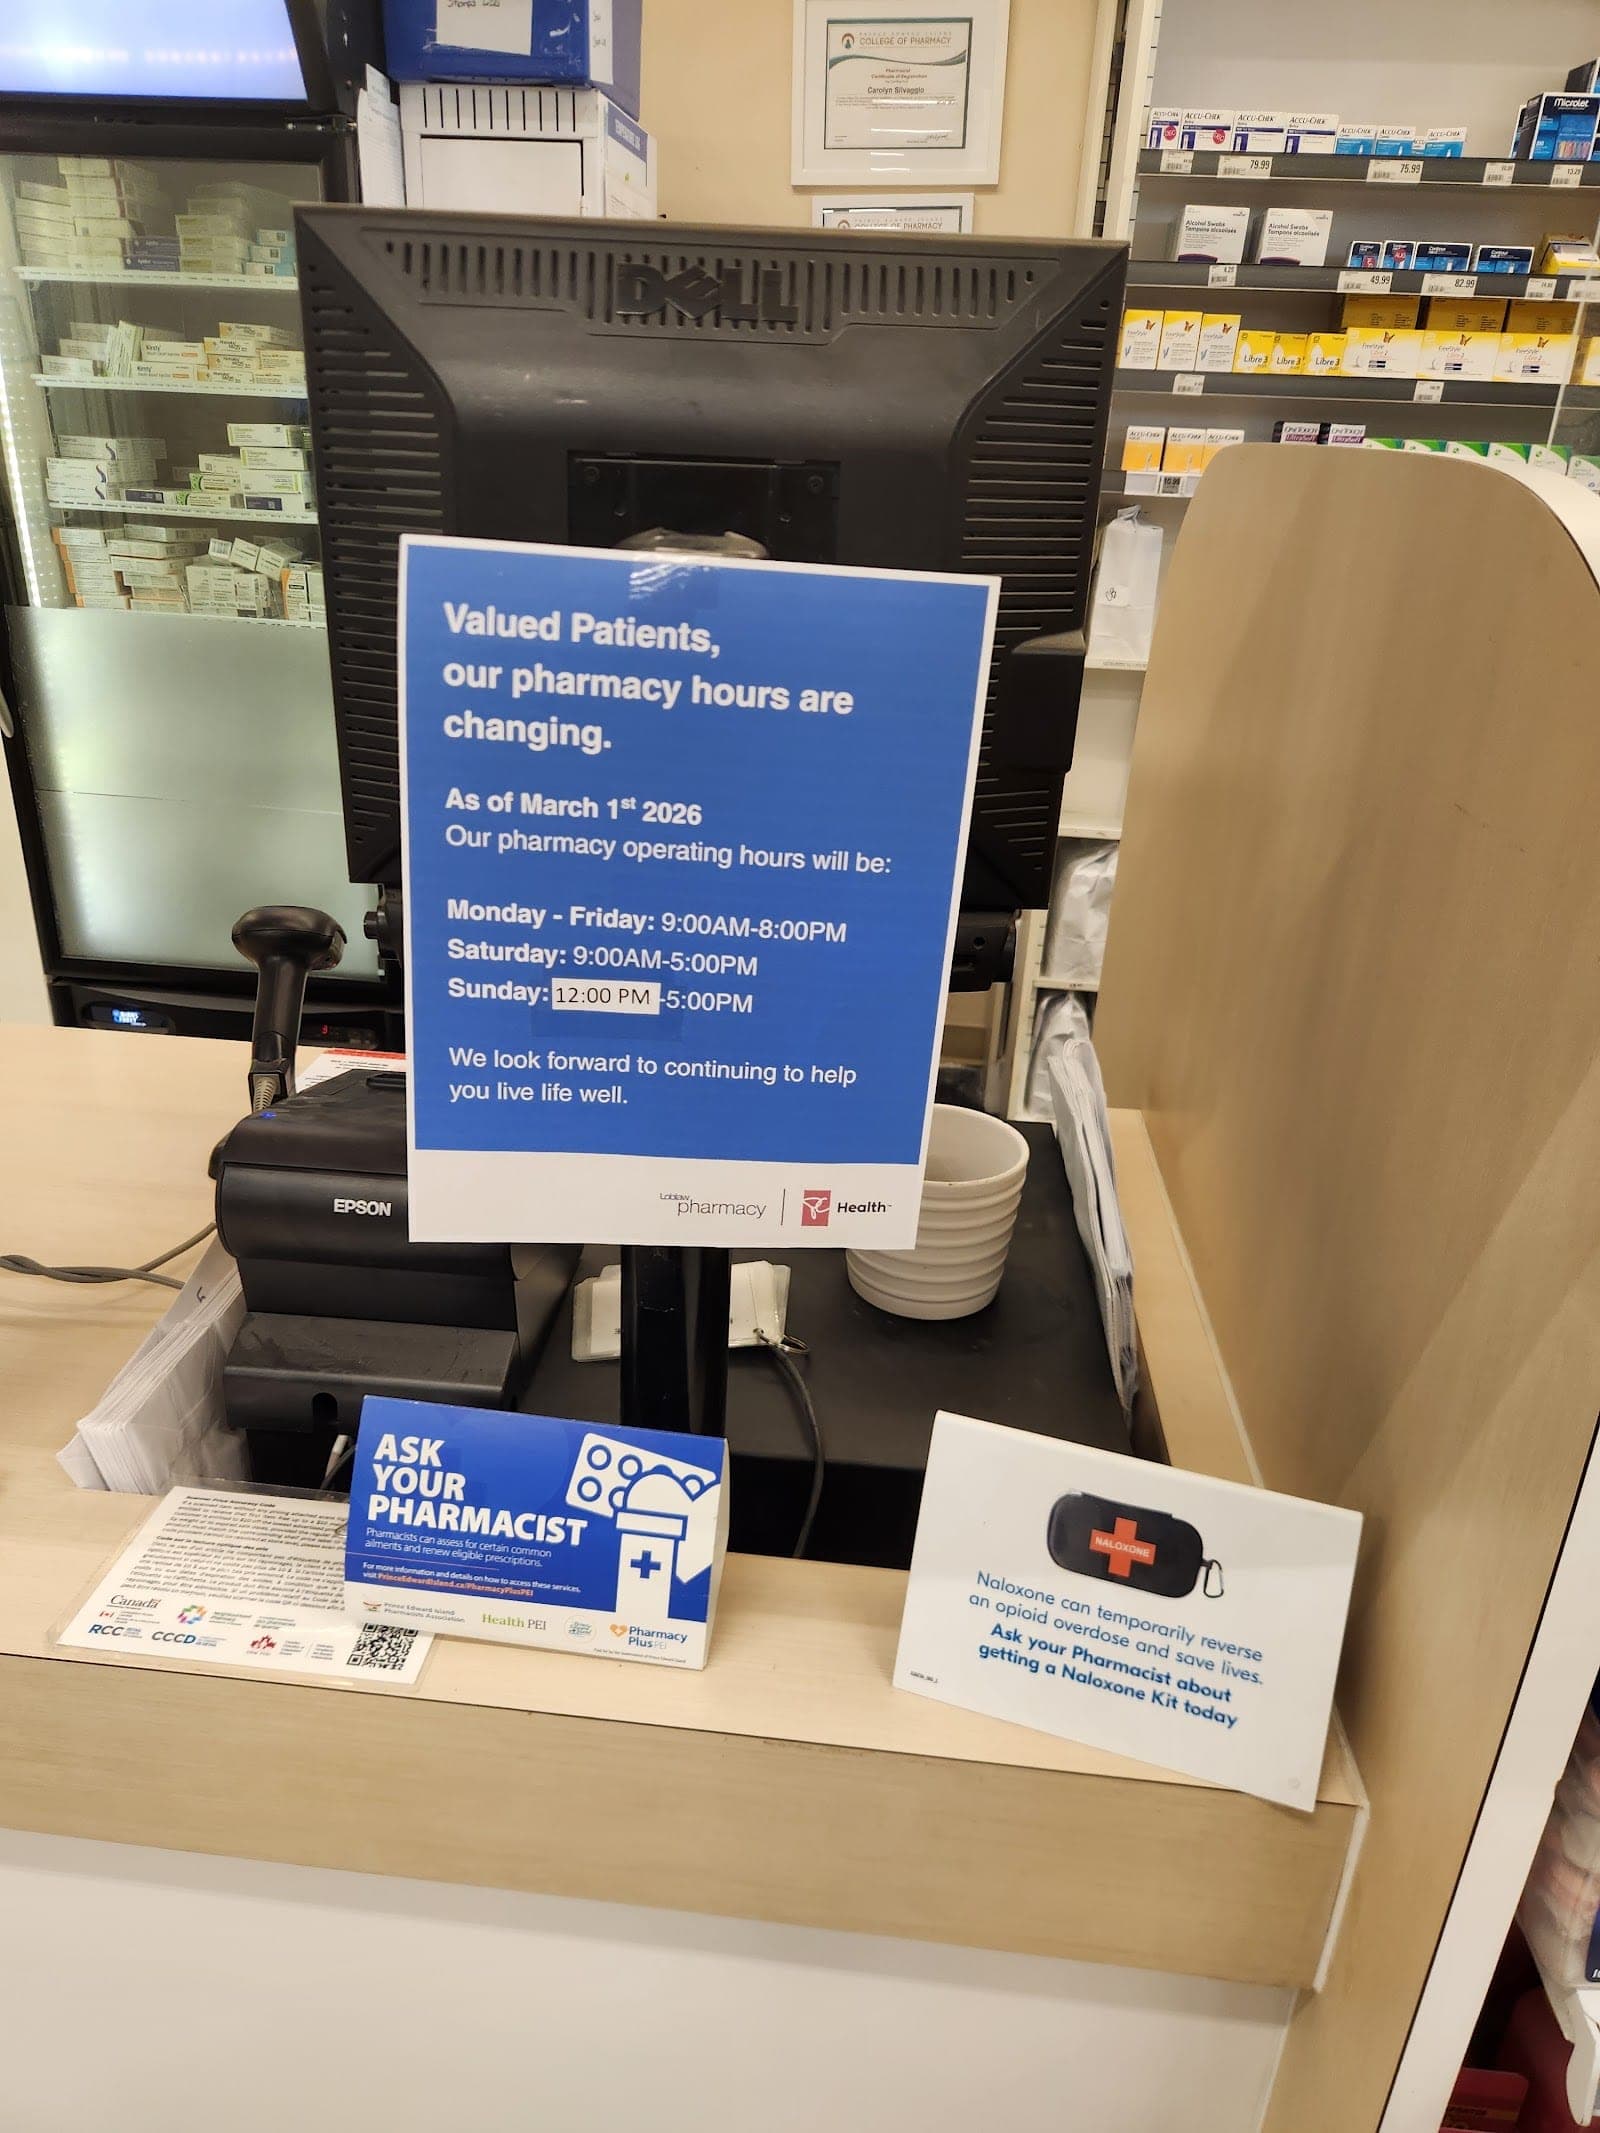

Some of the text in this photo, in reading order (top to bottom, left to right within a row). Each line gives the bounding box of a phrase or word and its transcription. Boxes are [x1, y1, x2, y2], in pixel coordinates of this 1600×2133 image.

[860, 37, 951, 45] COLLEGE OF PHARMACY
[868, 87, 924, 95] Carolyn Silvaggio
[1554, 98, 1590, 107] Microlet
[1250, 160, 1270, 169] 79.99
[1400, 164, 1420, 174] 75.99
[1370, 275, 1390, 285] 49.99
[1454, 279, 1474, 288] 82.99
[616, 263, 799, 322] DELL
[1244, 355, 1268, 364] Libre 3
[1277, 357, 1295, 365] Libre
[1316, 357, 1340, 366] Libre 3
[443, 601, 720, 659] Valued Patients,
[443, 662, 854, 715] our pharmacy hours are
[443, 710, 612, 755] changing.
[445, 787, 702, 826] As of March 1st 2026
[445, 824, 891, 874] Our pharmacy operating hours will be:
[448, 899, 847, 943] Monday - Friday: 9:00AM-8:00PM
[448, 938, 758, 977] Saturday: 9:00AM-5:00PM
[448, 977, 753, 1013] Sunday: 12:00 PM -5:00PM
[449, 1047, 857, 1088] We look forward to continuing to help
[449, 1082, 628, 1103] you live life well.
[333, 1198, 392, 1216] EPSON
[677, 1199, 767, 1219] pharmacy
[837, 1201, 886, 1213] Health
[374, 1433, 445, 1467] ASK
[372, 1463, 466, 1501] YOUR
[367, 1494, 588, 1546] PHARMACIST
[365, 1540, 543, 1568] ailments and renew eligible prescriptions.
[366, 1528, 551, 1558] Pharmacists can assess for certain common
[1095, 1536, 1150, 1558] NALOXONE
[363, 1571, 377, 1579] visit
[363, 1562, 375, 1570] For
[394, 1565, 434, 1577] information
[436, 1570, 450, 1578] and
[450, 1571, 473, 1581] details
[485, 1575, 500, 1583] how
[510, 1579, 531, 1588] access
[532, 1580, 550, 1590] these
[551, 1583, 581, 1593] services.
[111, 1594, 161, 1610] Canada
[482, 1614, 546, 1631] Health PEI
[977, 1570, 1263, 1662] Naloxone can temporarily reverse
[88, 1624, 124, 1637] RCC
[152, 1631, 196, 1645] CCCD
[629, 1626, 688, 1643] Pharmacy
[969, 1594, 1263, 1685] an opioid overdose and save lives.
[990, 1623, 1232, 1702] Ask your Pharmacist about
[978, 1644, 1238, 1729] getting a Naloxone Kit today
